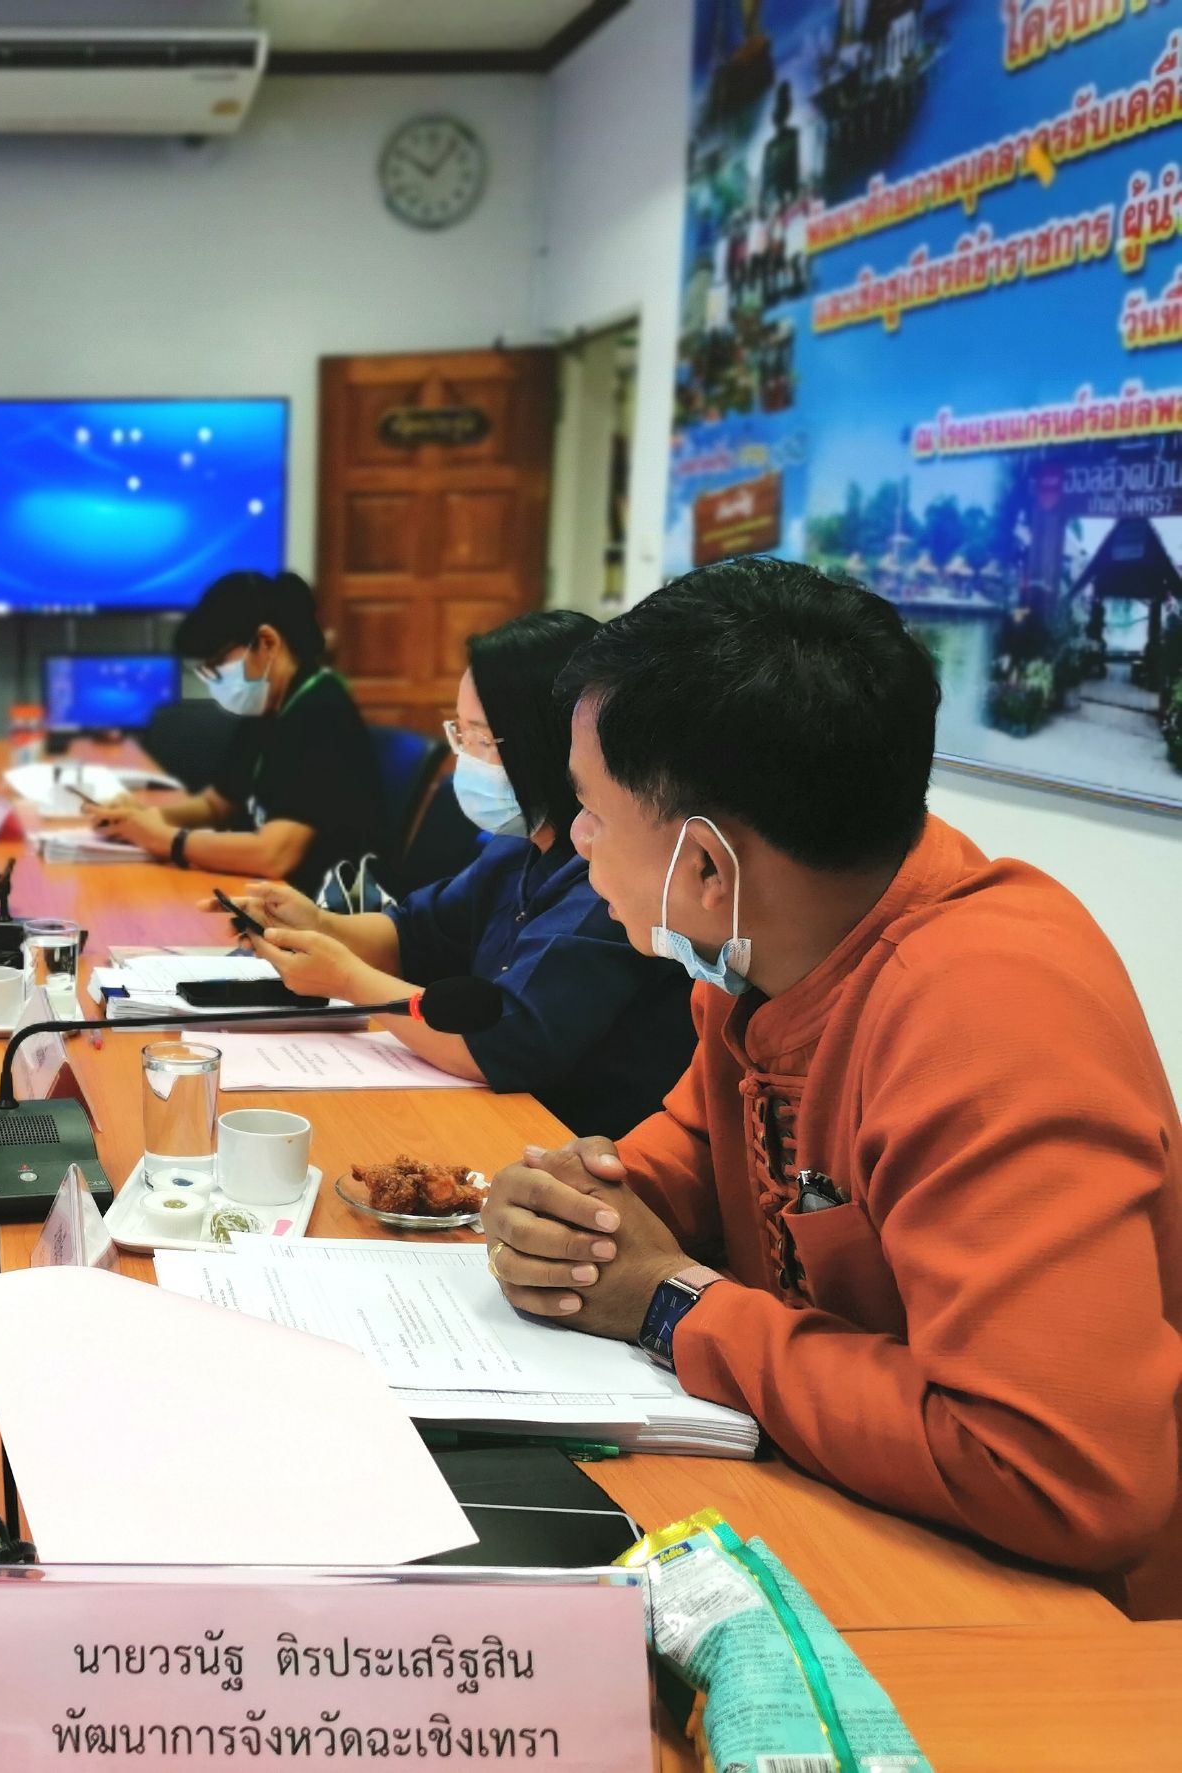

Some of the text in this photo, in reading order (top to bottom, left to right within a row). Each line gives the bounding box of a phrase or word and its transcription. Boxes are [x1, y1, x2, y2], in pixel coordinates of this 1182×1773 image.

[73, 1629, 534, 1694] นายวรนัฐ ติรประเสริฐสิน
[51, 1706, 559, 1757] พัฒนาการจังหวัดฉะเชิงเทรา
